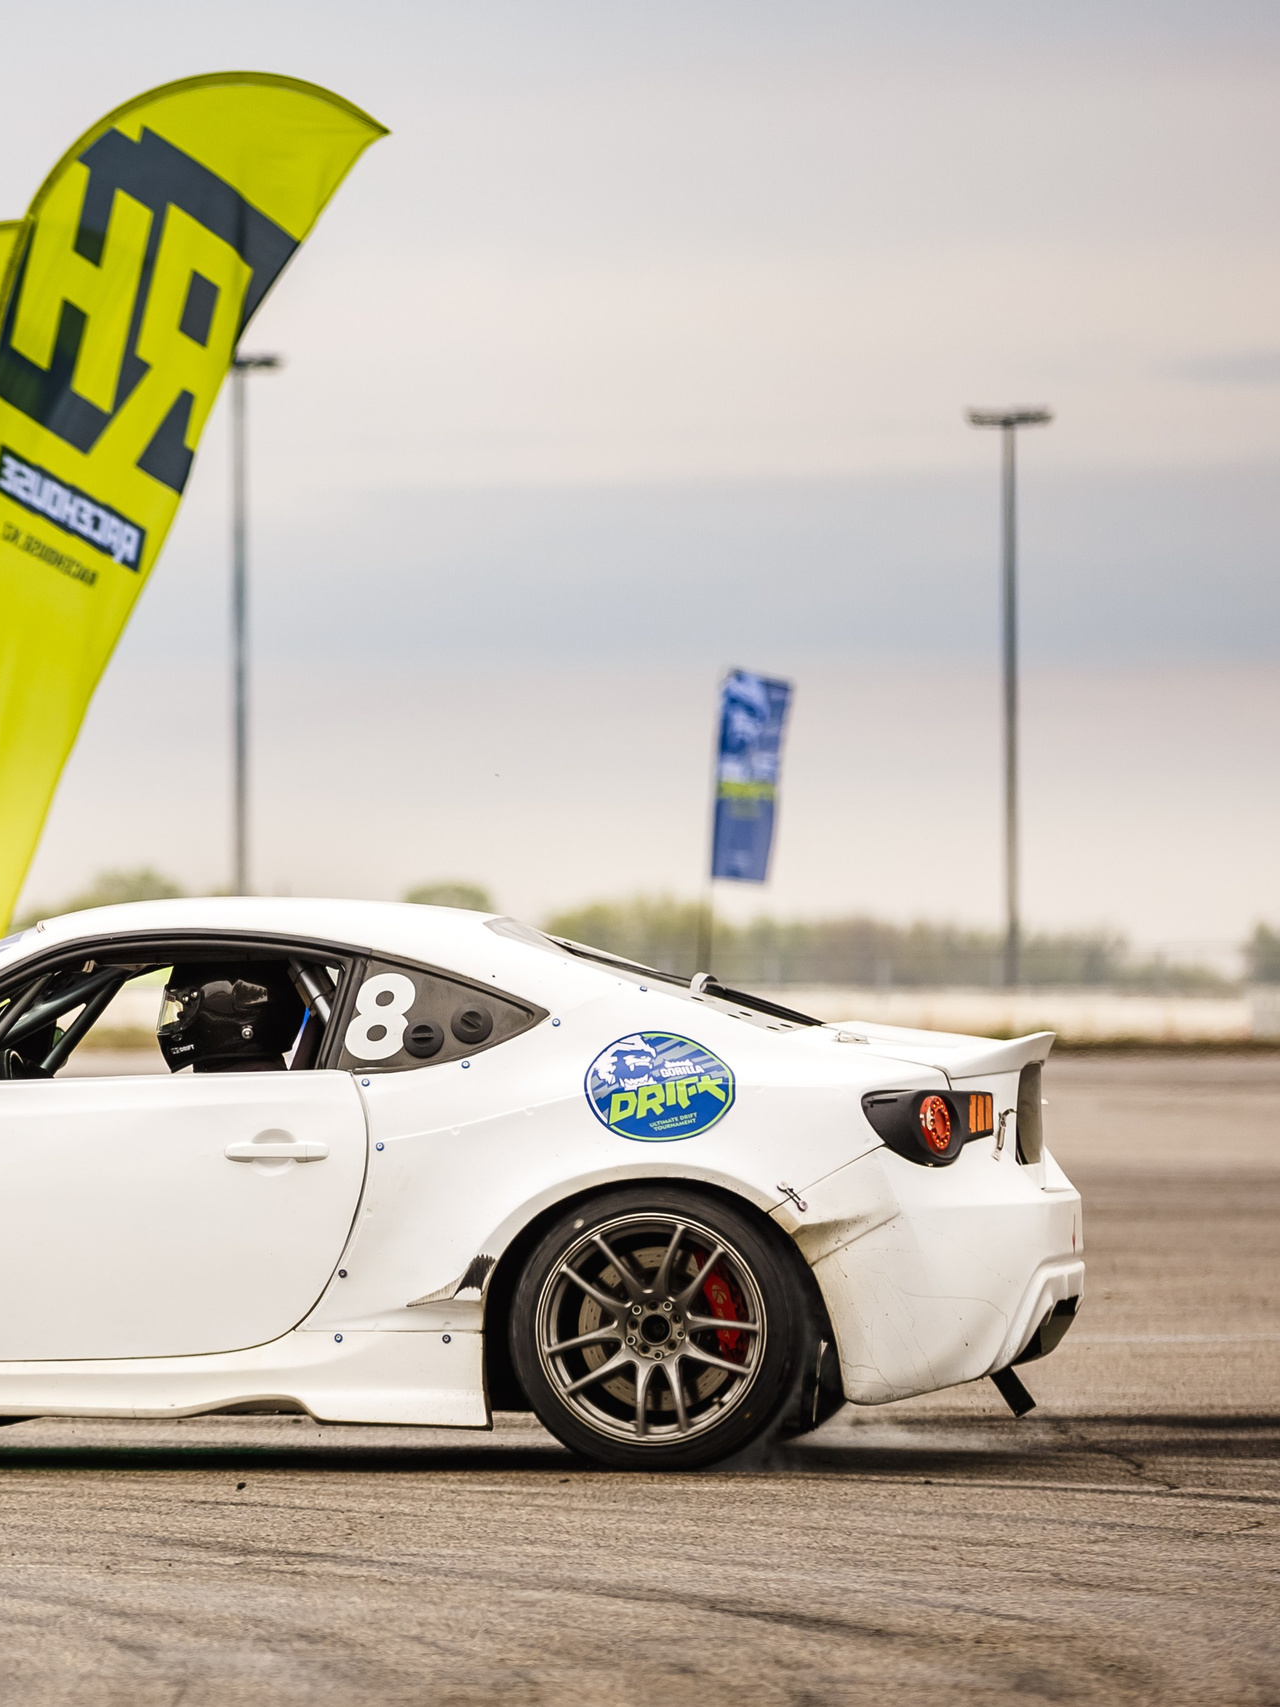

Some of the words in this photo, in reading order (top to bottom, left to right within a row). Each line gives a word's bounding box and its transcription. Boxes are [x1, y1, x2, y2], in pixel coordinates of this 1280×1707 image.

[344, 972, 416, 1061] 8
[659, 1064, 705, 1078] GORILLA
[609, 1075, 726, 1125] DRIFT
[649, 1116, 679, 1128] ULTIMATE
[679, 1112, 698, 1122] DRIFT
[653, 1118, 697, 1132] TOURNAMENT
